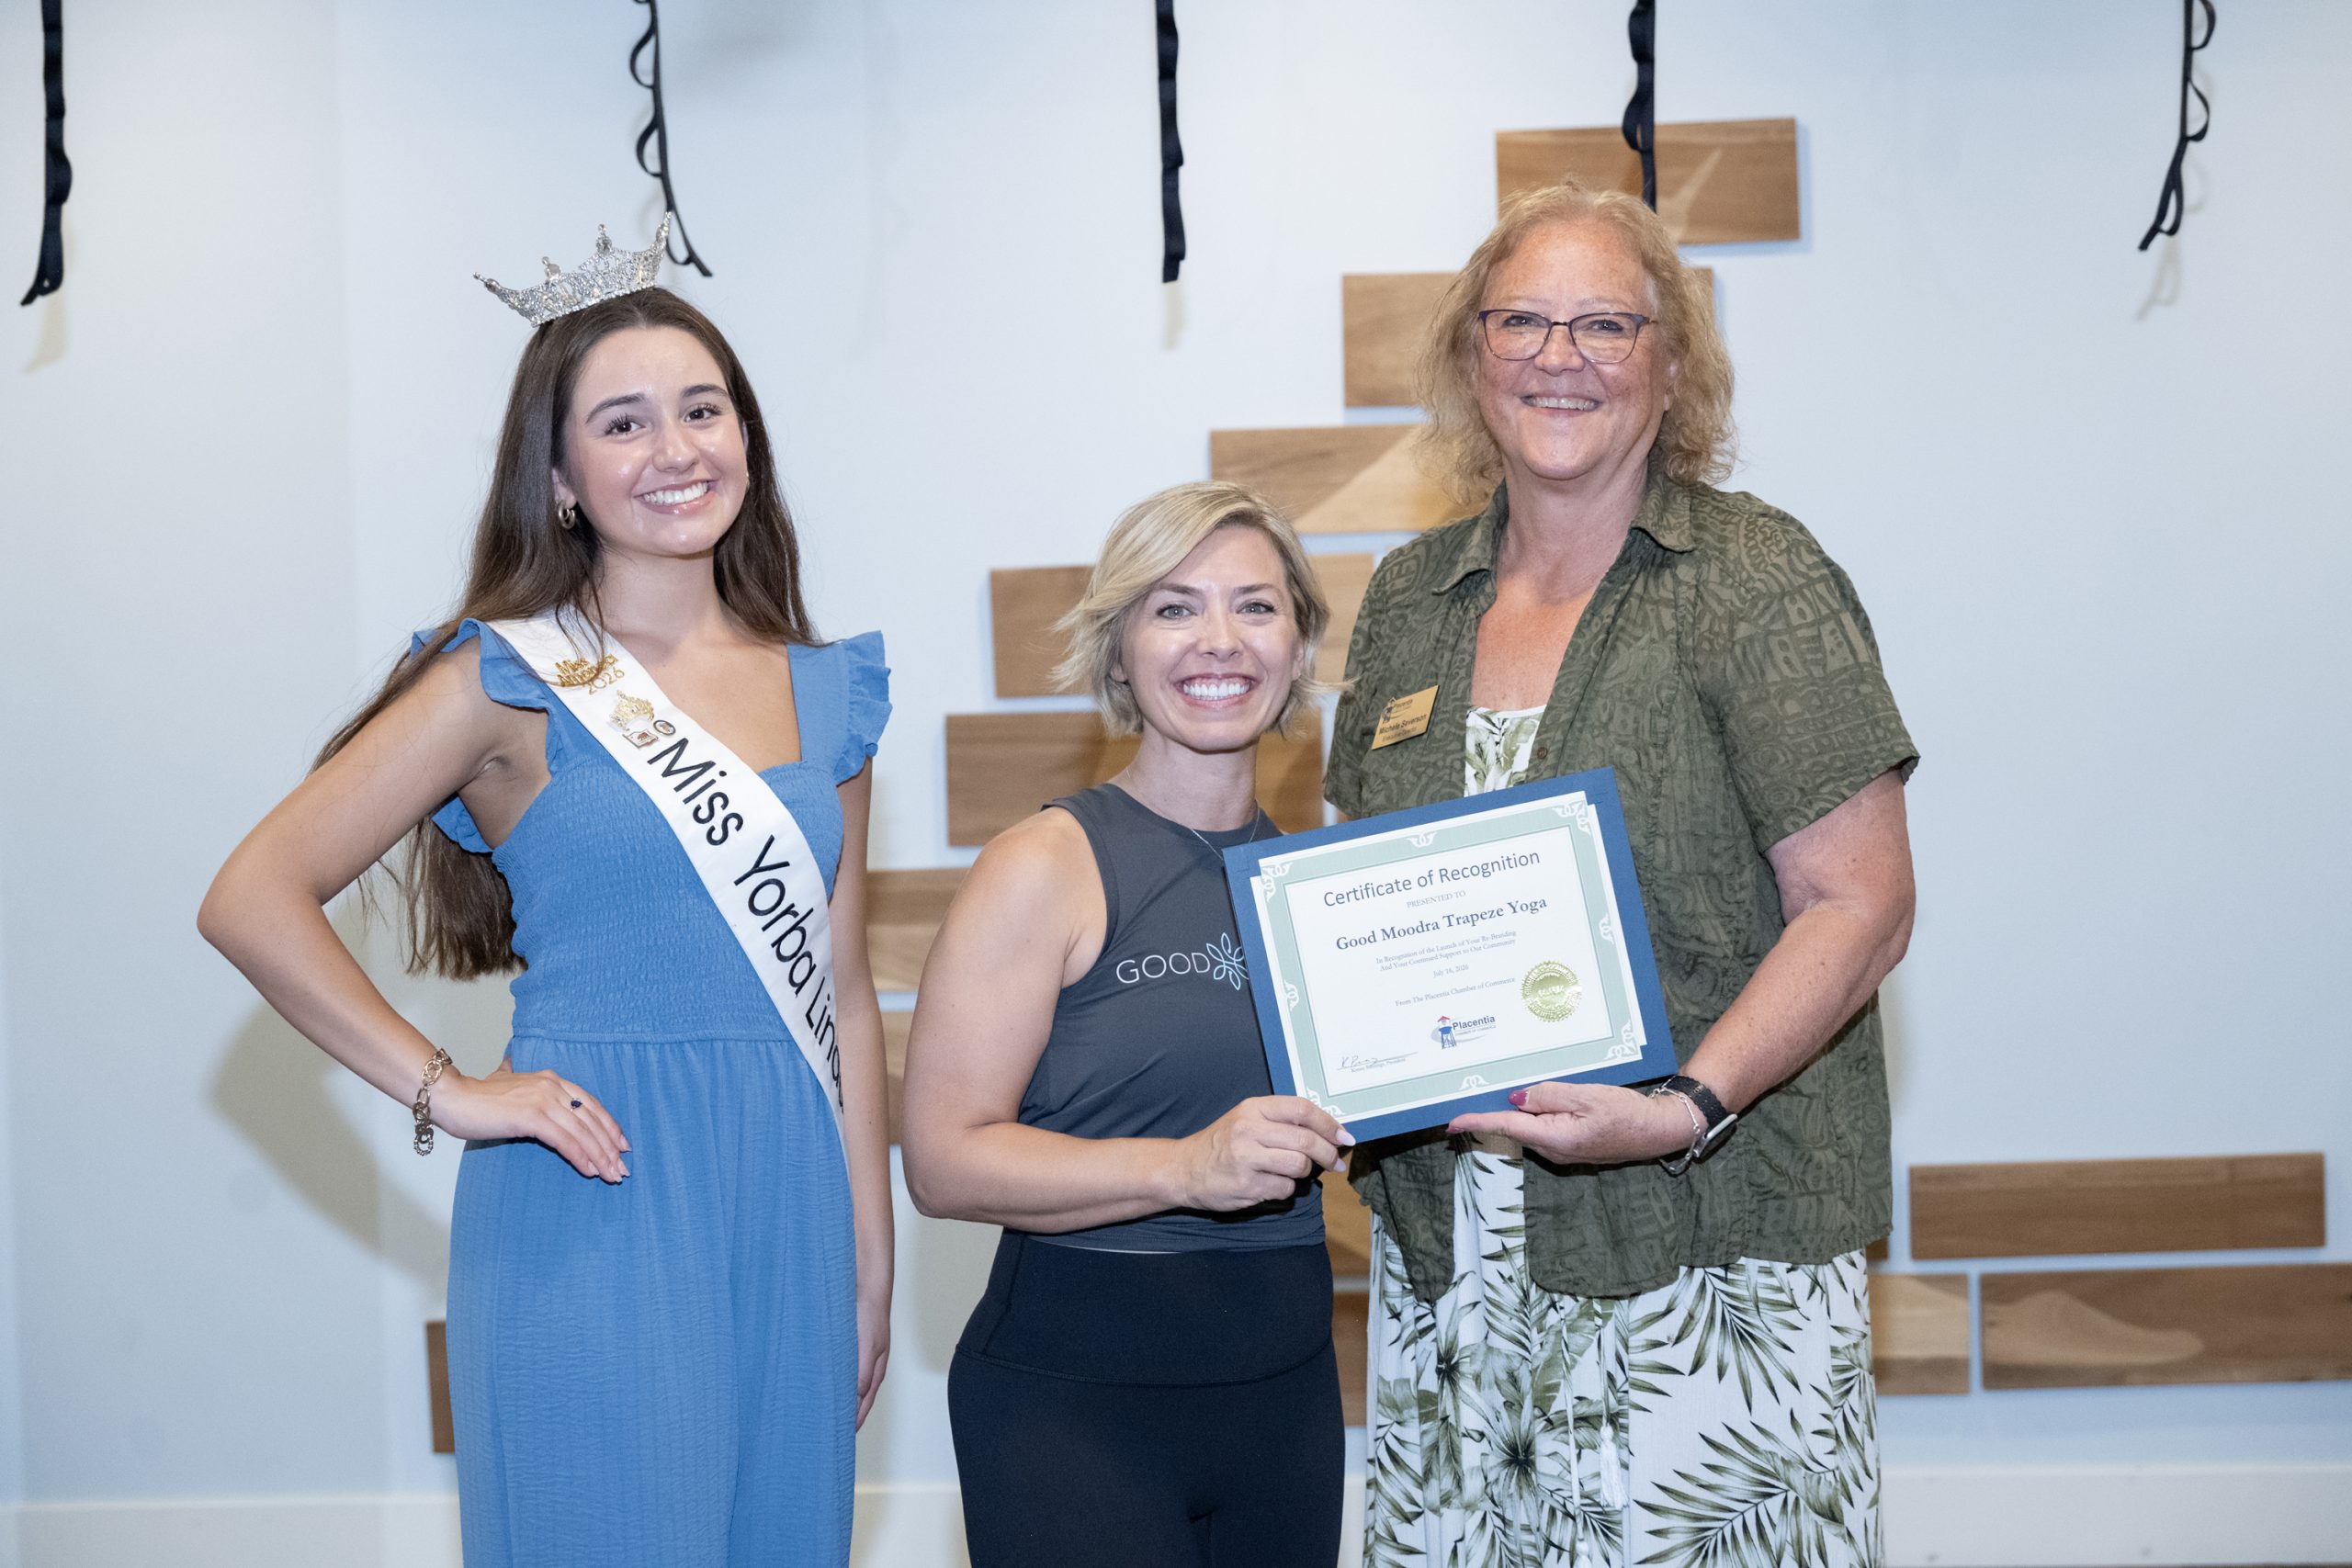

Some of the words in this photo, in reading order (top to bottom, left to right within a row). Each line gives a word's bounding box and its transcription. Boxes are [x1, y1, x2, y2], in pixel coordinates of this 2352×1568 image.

[589, 667, 625, 695] 2026
[647, 738, 744, 846] Miss
[733, 834, 817, 998] Yorba
[1323, 878, 1412, 908] Certificate
[1417, 869, 1435, 888] of
[1439, 852, 1541, 884] Recognition
[1407, 893, 1453, 908] PRESENTED
[1453, 890, 1466, 900] TO
[1336, 931, 1377, 951] Good
[1380, 920, 1441, 942] Moodra
[1442, 905, 1504, 929] Trapeze
[1507, 898, 1548, 915] Yoga
[1376, 956, 1384, 964] In
[1384, 950, 1418, 964] Recognition
[1436, 942, 1458, 953] Launch
[1466, 937, 1480, 945] Your
[1380, 964, 1393, 972] And
[1393, 960, 1408, 969] Your
[1440, 949, 1463, 962] Support
[1116, 952, 1211, 984] GOOD
[1433, 969, 1444, 978] July
[1395, 998, 1412, 1007] From
[1413, 995, 1423, 1003] The
[1425, 990, 1451, 1001] Placentia
[1451, 985, 1476, 996] Chamber
[1484, 976, 1515, 988] Commerce
[1453, 1015, 1496, 1031] Placentia
